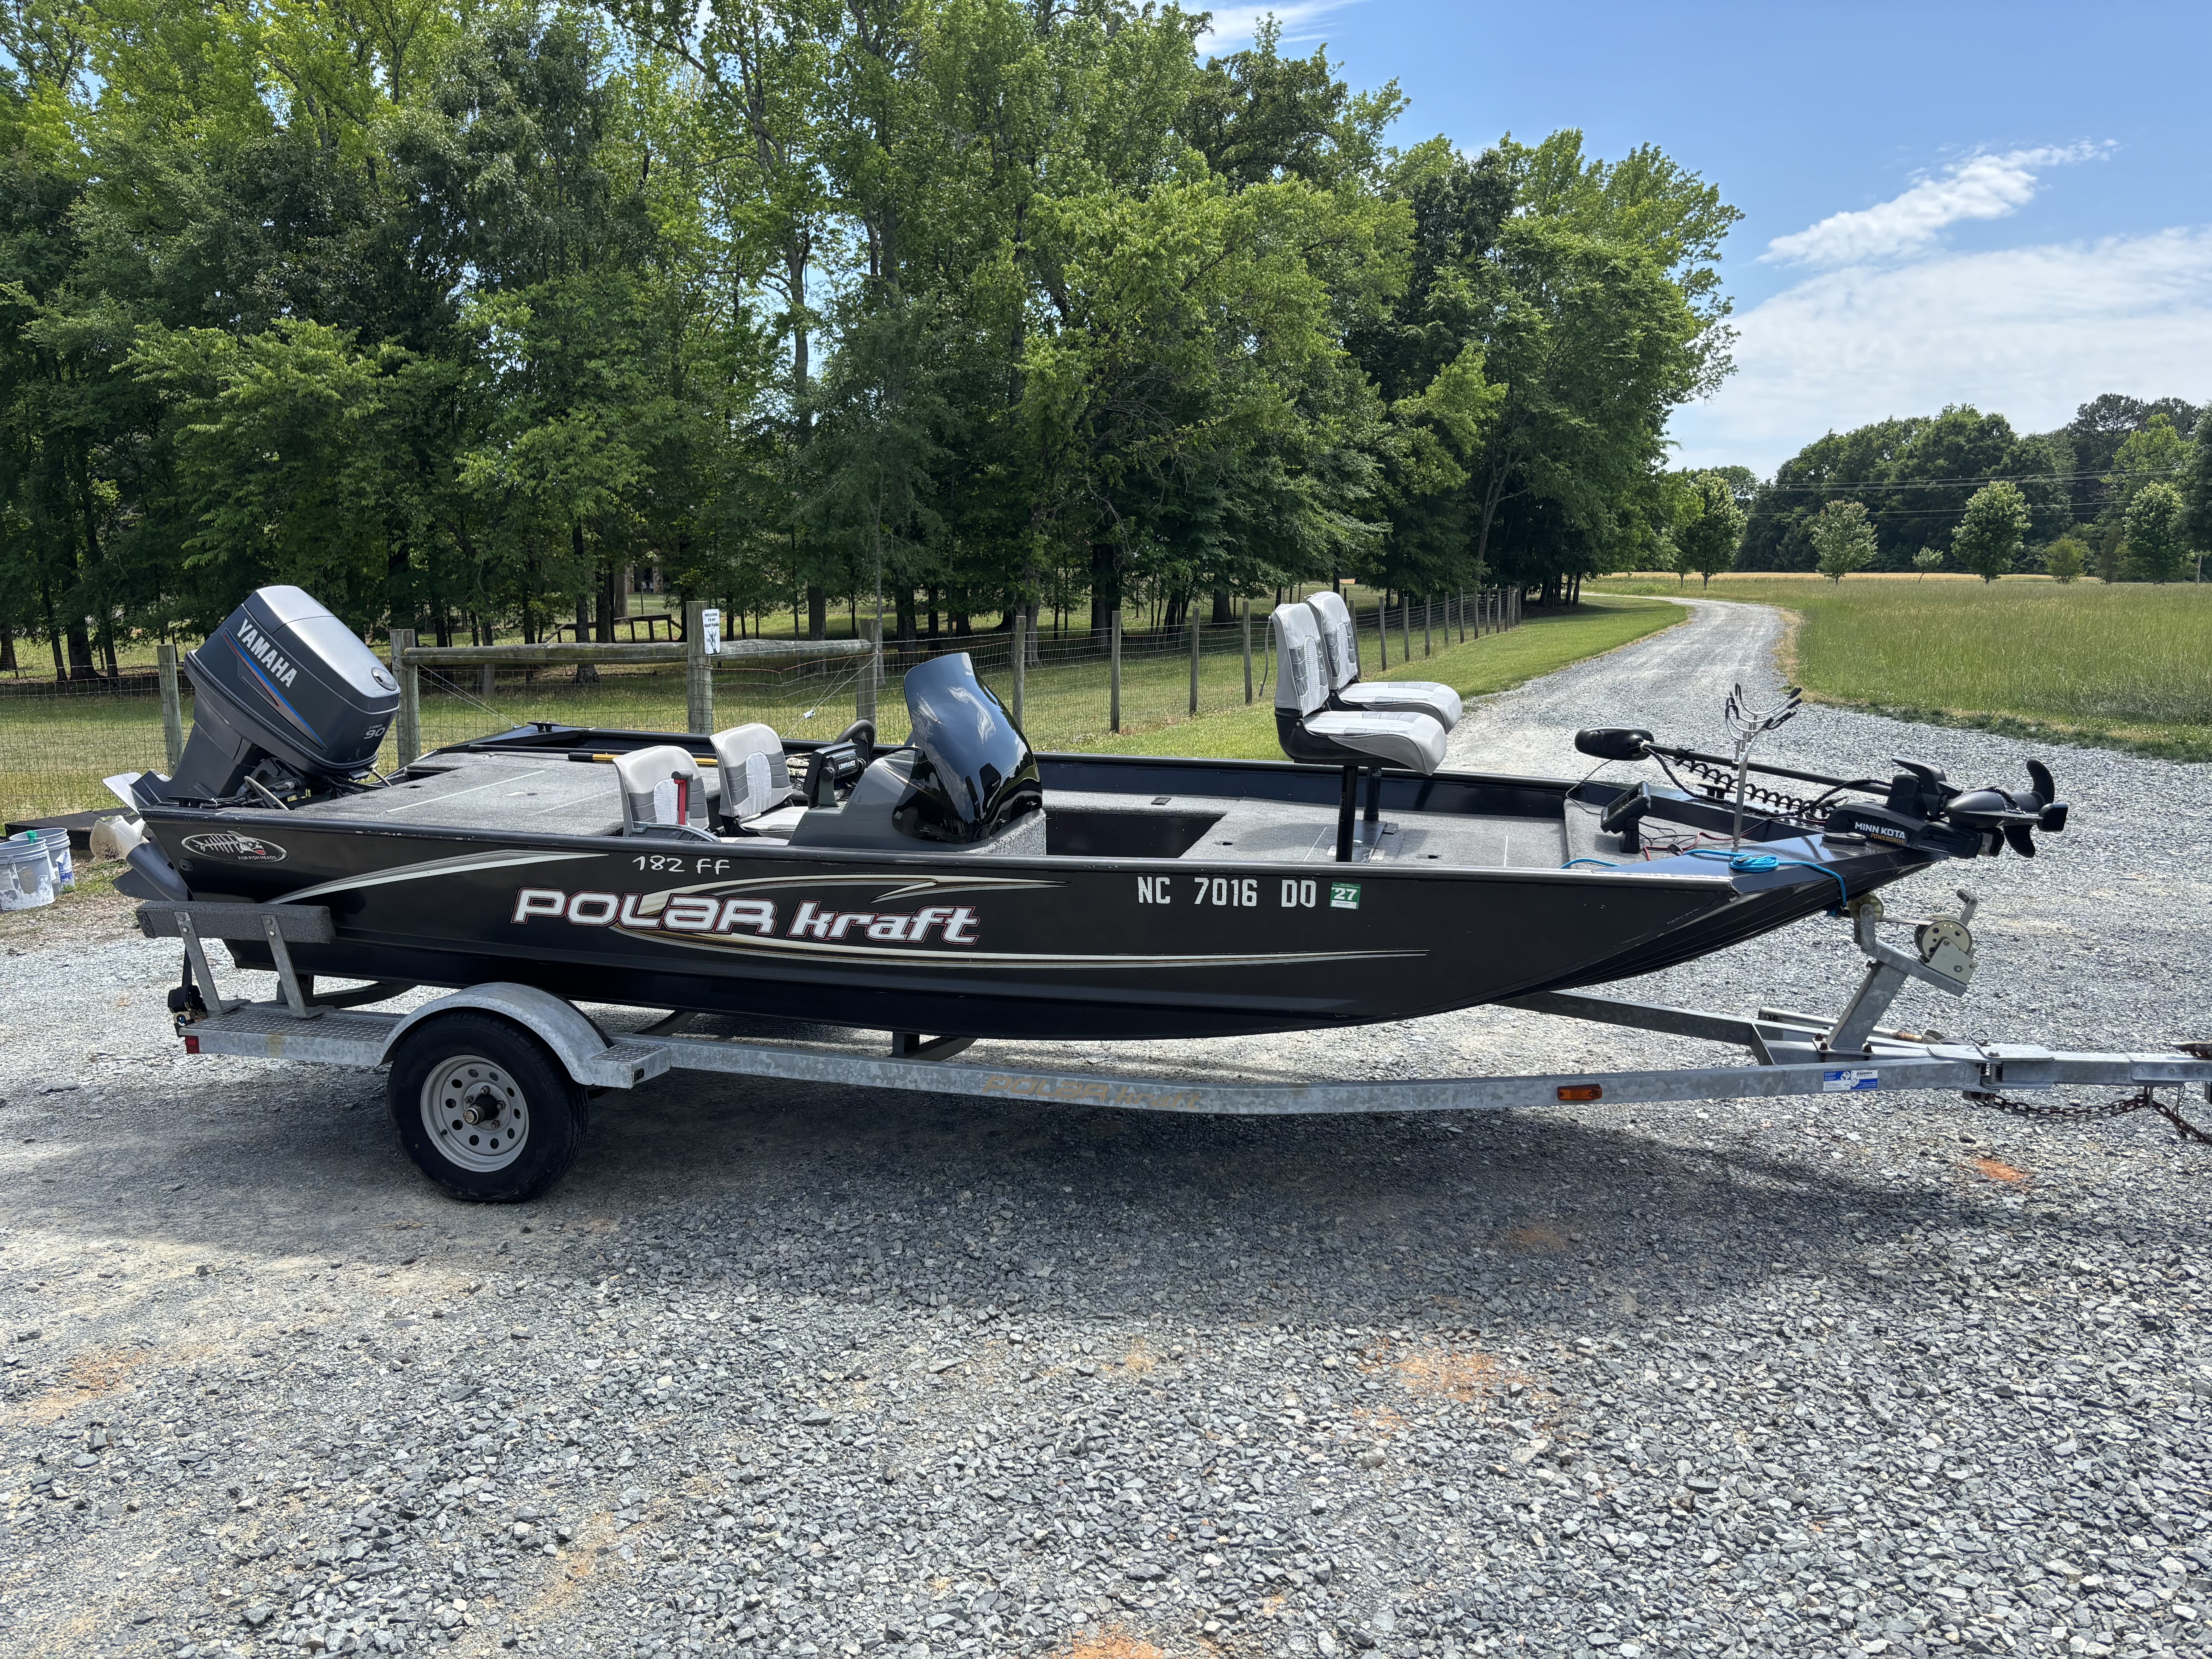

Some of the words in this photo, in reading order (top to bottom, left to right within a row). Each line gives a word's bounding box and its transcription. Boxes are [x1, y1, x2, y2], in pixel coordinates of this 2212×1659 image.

[237, 618, 297, 688] YAMAHA
[364, 727, 386, 739] 90
[838, 760, 856, 770] LOWRANCE
[1855, 822, 1879, 834] MINN
[1881, 827, 1906, 839] KOTA
[1870, 833, 1906, 845] POWERDRIVE
[632, 855, 685, 872] 182
[696, 858, 730, 875] FF
[1138, 876, 1171, 904] NC
[1194, 877, 1257, 907] 7016
[1334, 887, 1357, 900] 27
[786, 899, 981, 945] kraft
